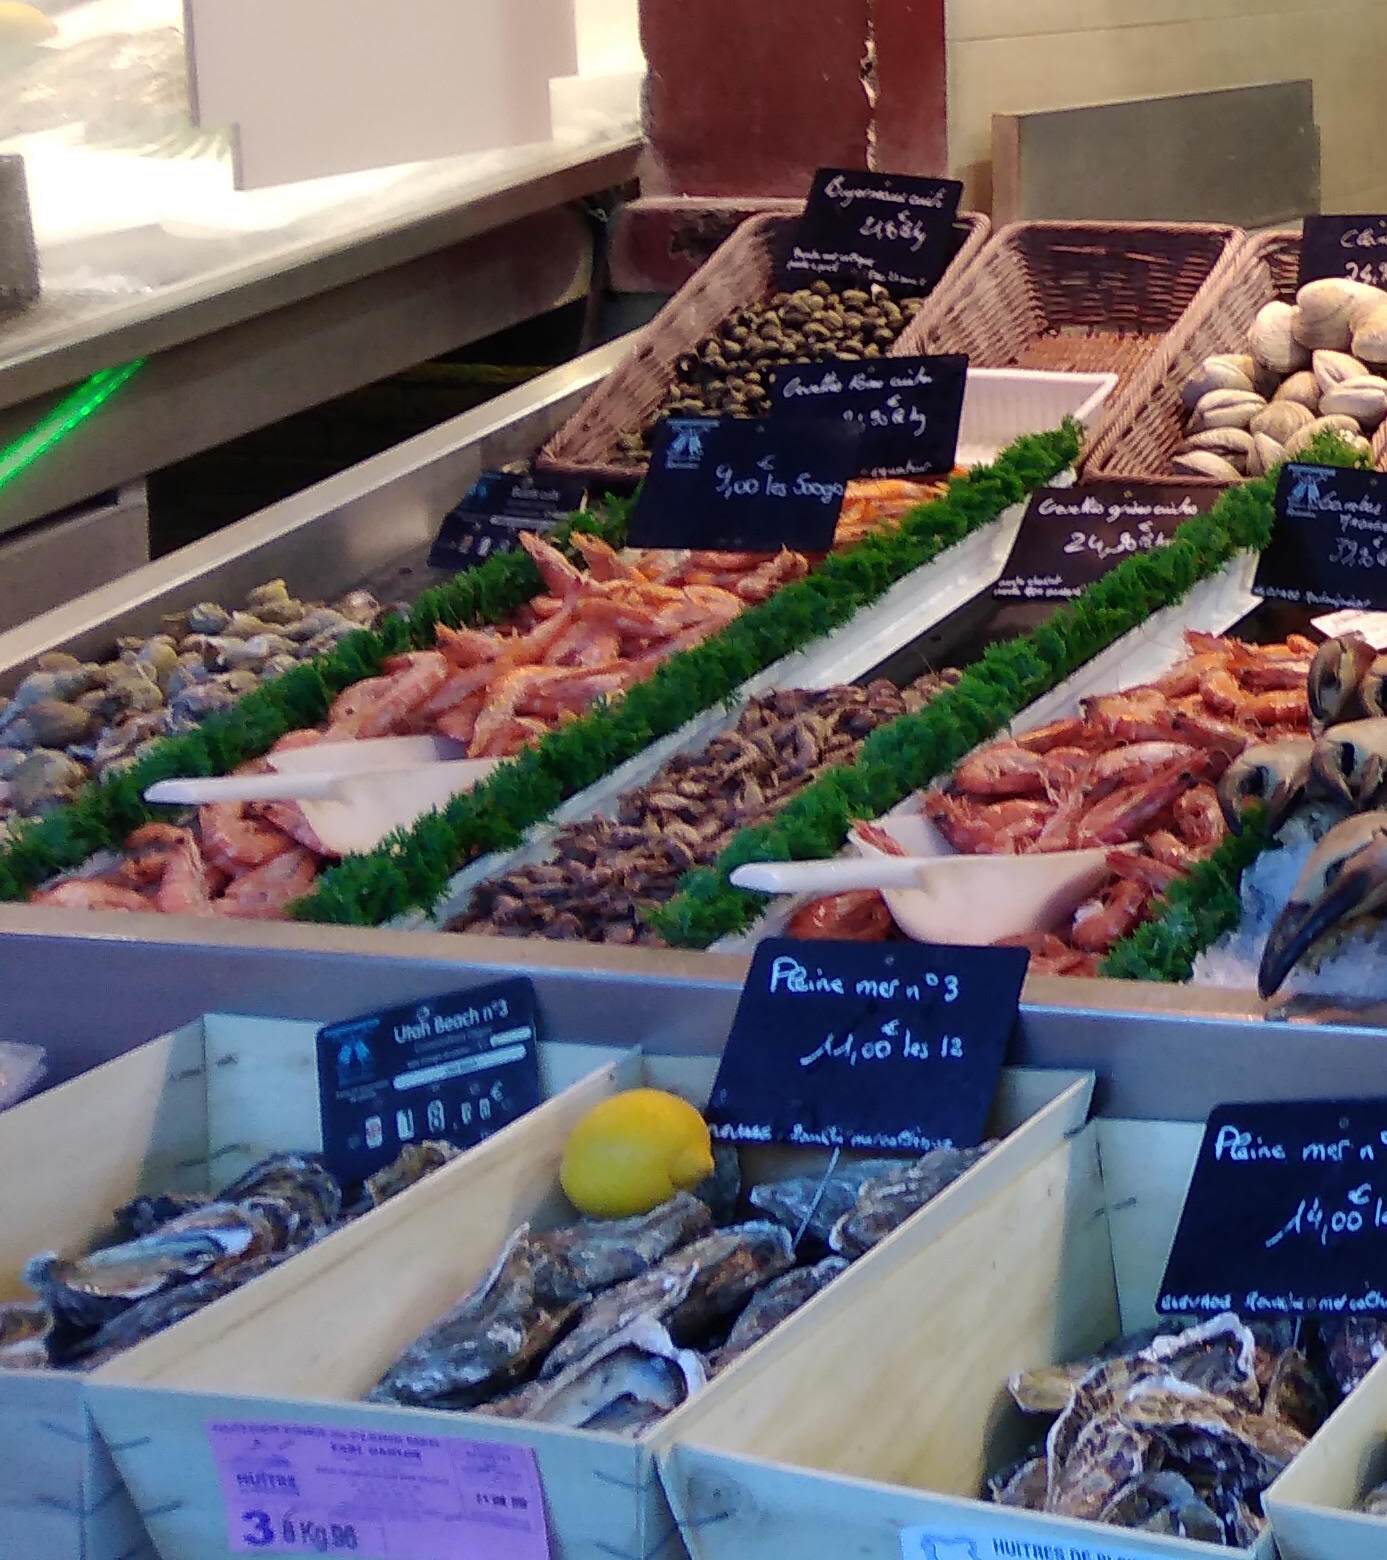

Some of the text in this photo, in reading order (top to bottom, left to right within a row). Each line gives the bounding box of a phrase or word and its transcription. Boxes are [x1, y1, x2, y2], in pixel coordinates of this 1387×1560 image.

[855, 976, 901, 1000] mer
[393, 1020, 432, 1044] Utah
[433, 1005, 480, 1035] Beach
[902, 1028, 931, 1062] les
[1301, 1138, 1351, 1163] mer
[240, 1509, 275, 1547] 3
